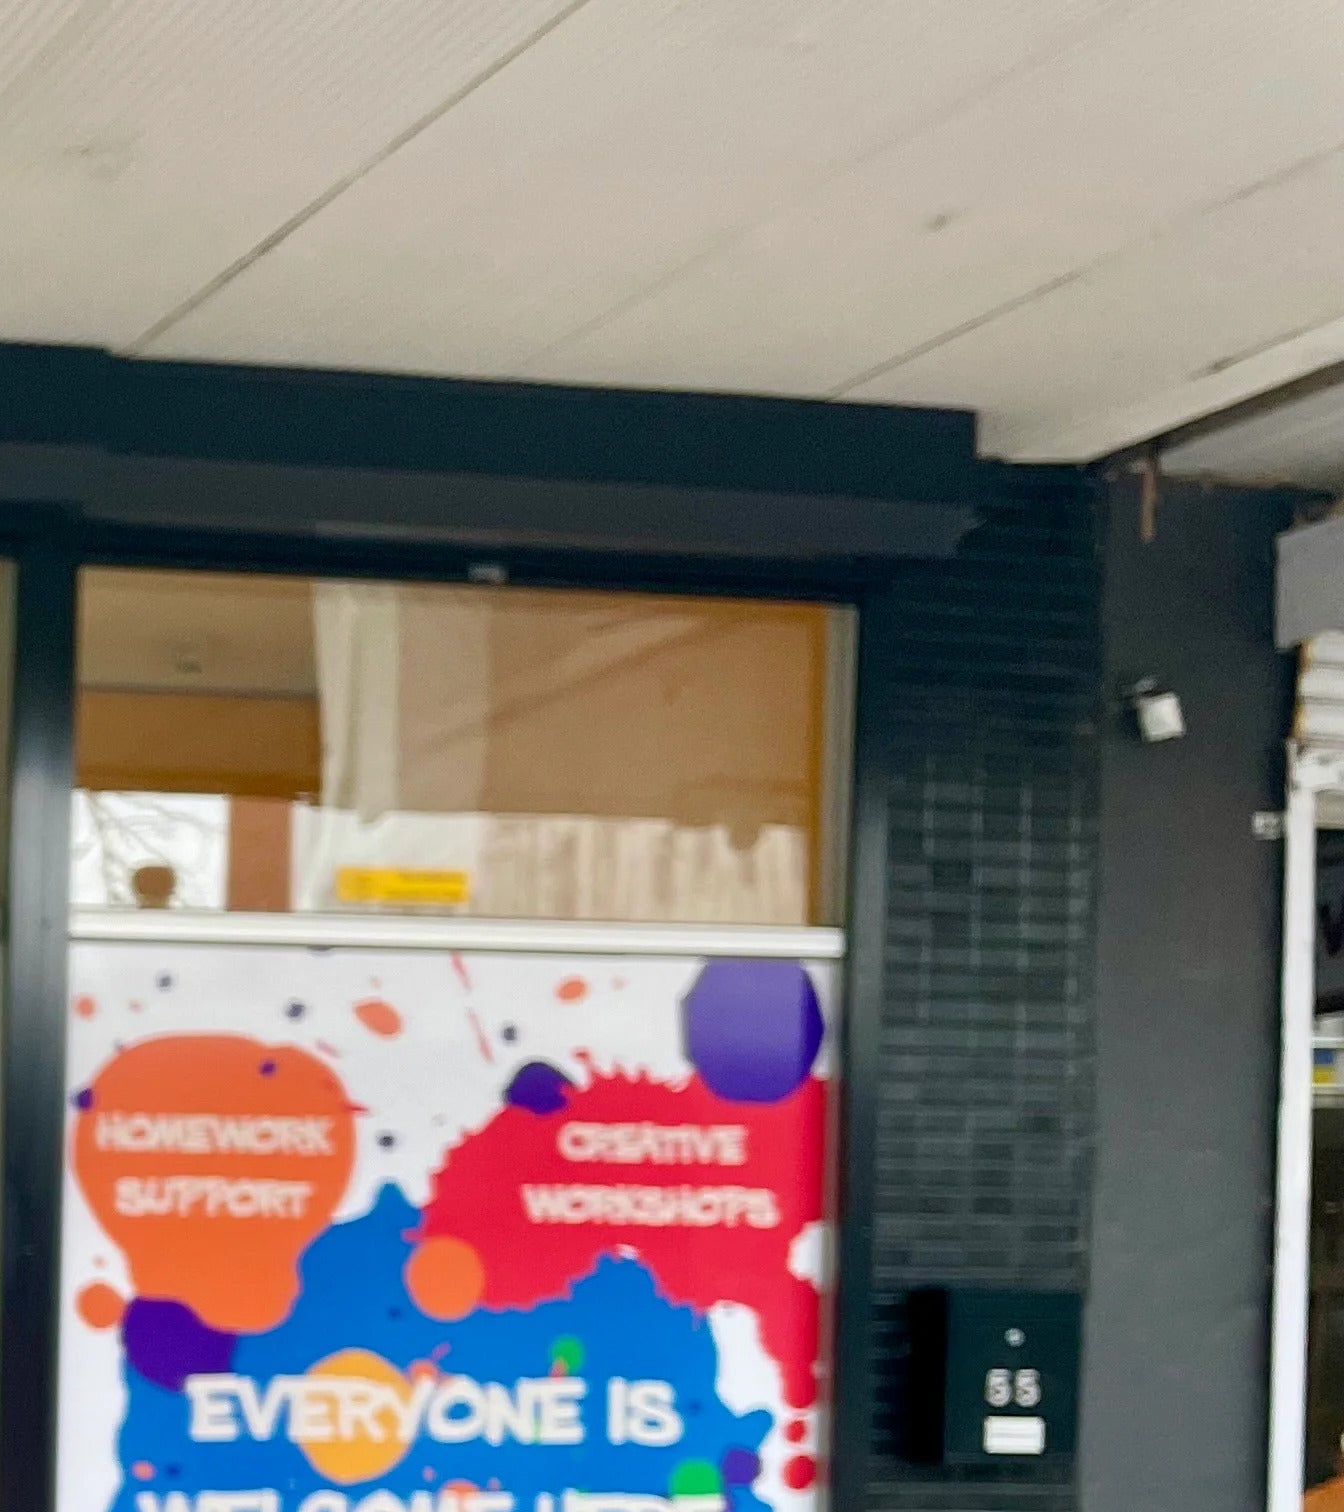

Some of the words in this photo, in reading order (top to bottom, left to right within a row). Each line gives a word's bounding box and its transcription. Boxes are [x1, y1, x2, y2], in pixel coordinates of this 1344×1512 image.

[96, 1112, 334, 1156] HOMEWORK
[558, 1121, 748, 1166] CREATIVE
[115, 1176, 314, 1217] SUPPORT
[522, 1184, 781, 1228] WORKSHOPS
[184, 1374, 586, 1446] EVERYONE
[607, 1377, 684, 1446] IS
